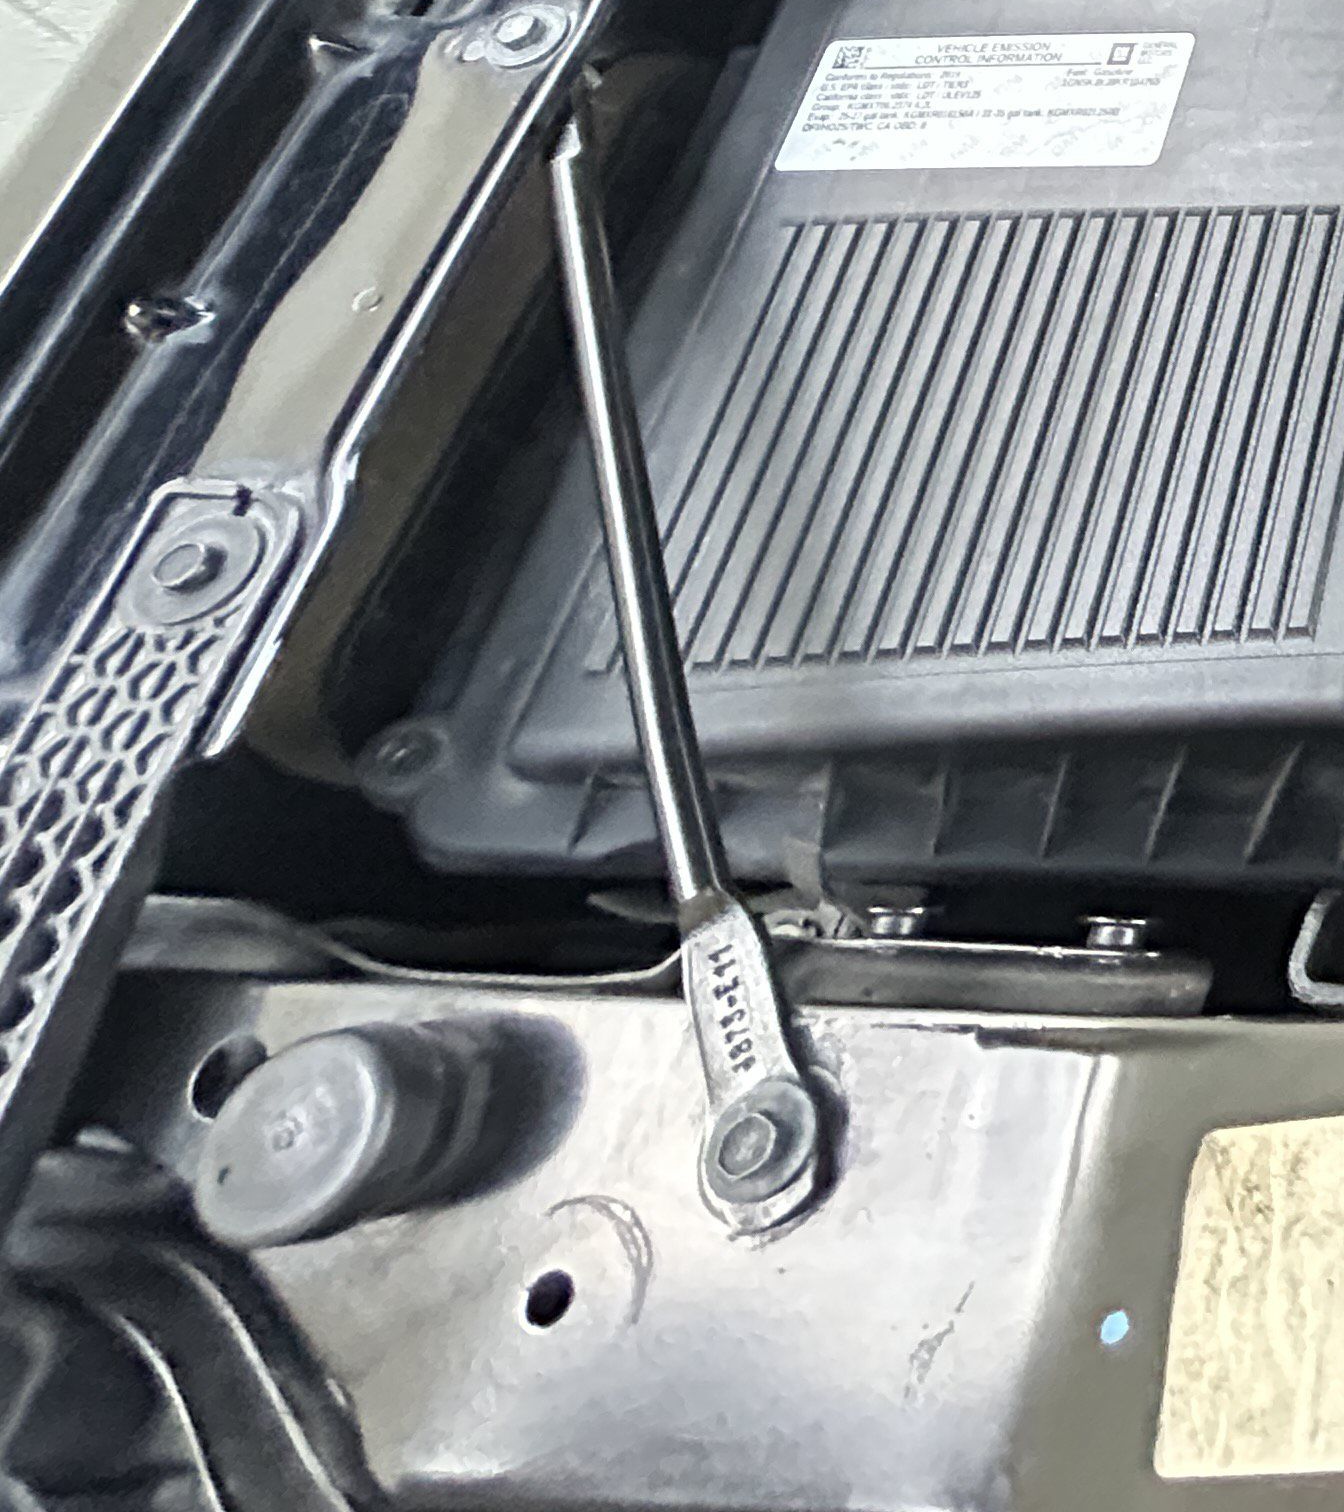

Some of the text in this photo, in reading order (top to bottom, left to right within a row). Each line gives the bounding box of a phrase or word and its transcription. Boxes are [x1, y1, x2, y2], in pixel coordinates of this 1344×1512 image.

[937, 42, 1051, 53] VEHICLE EMISSION
[914, 52, 1063, 64] CONTROL INFORMATION
